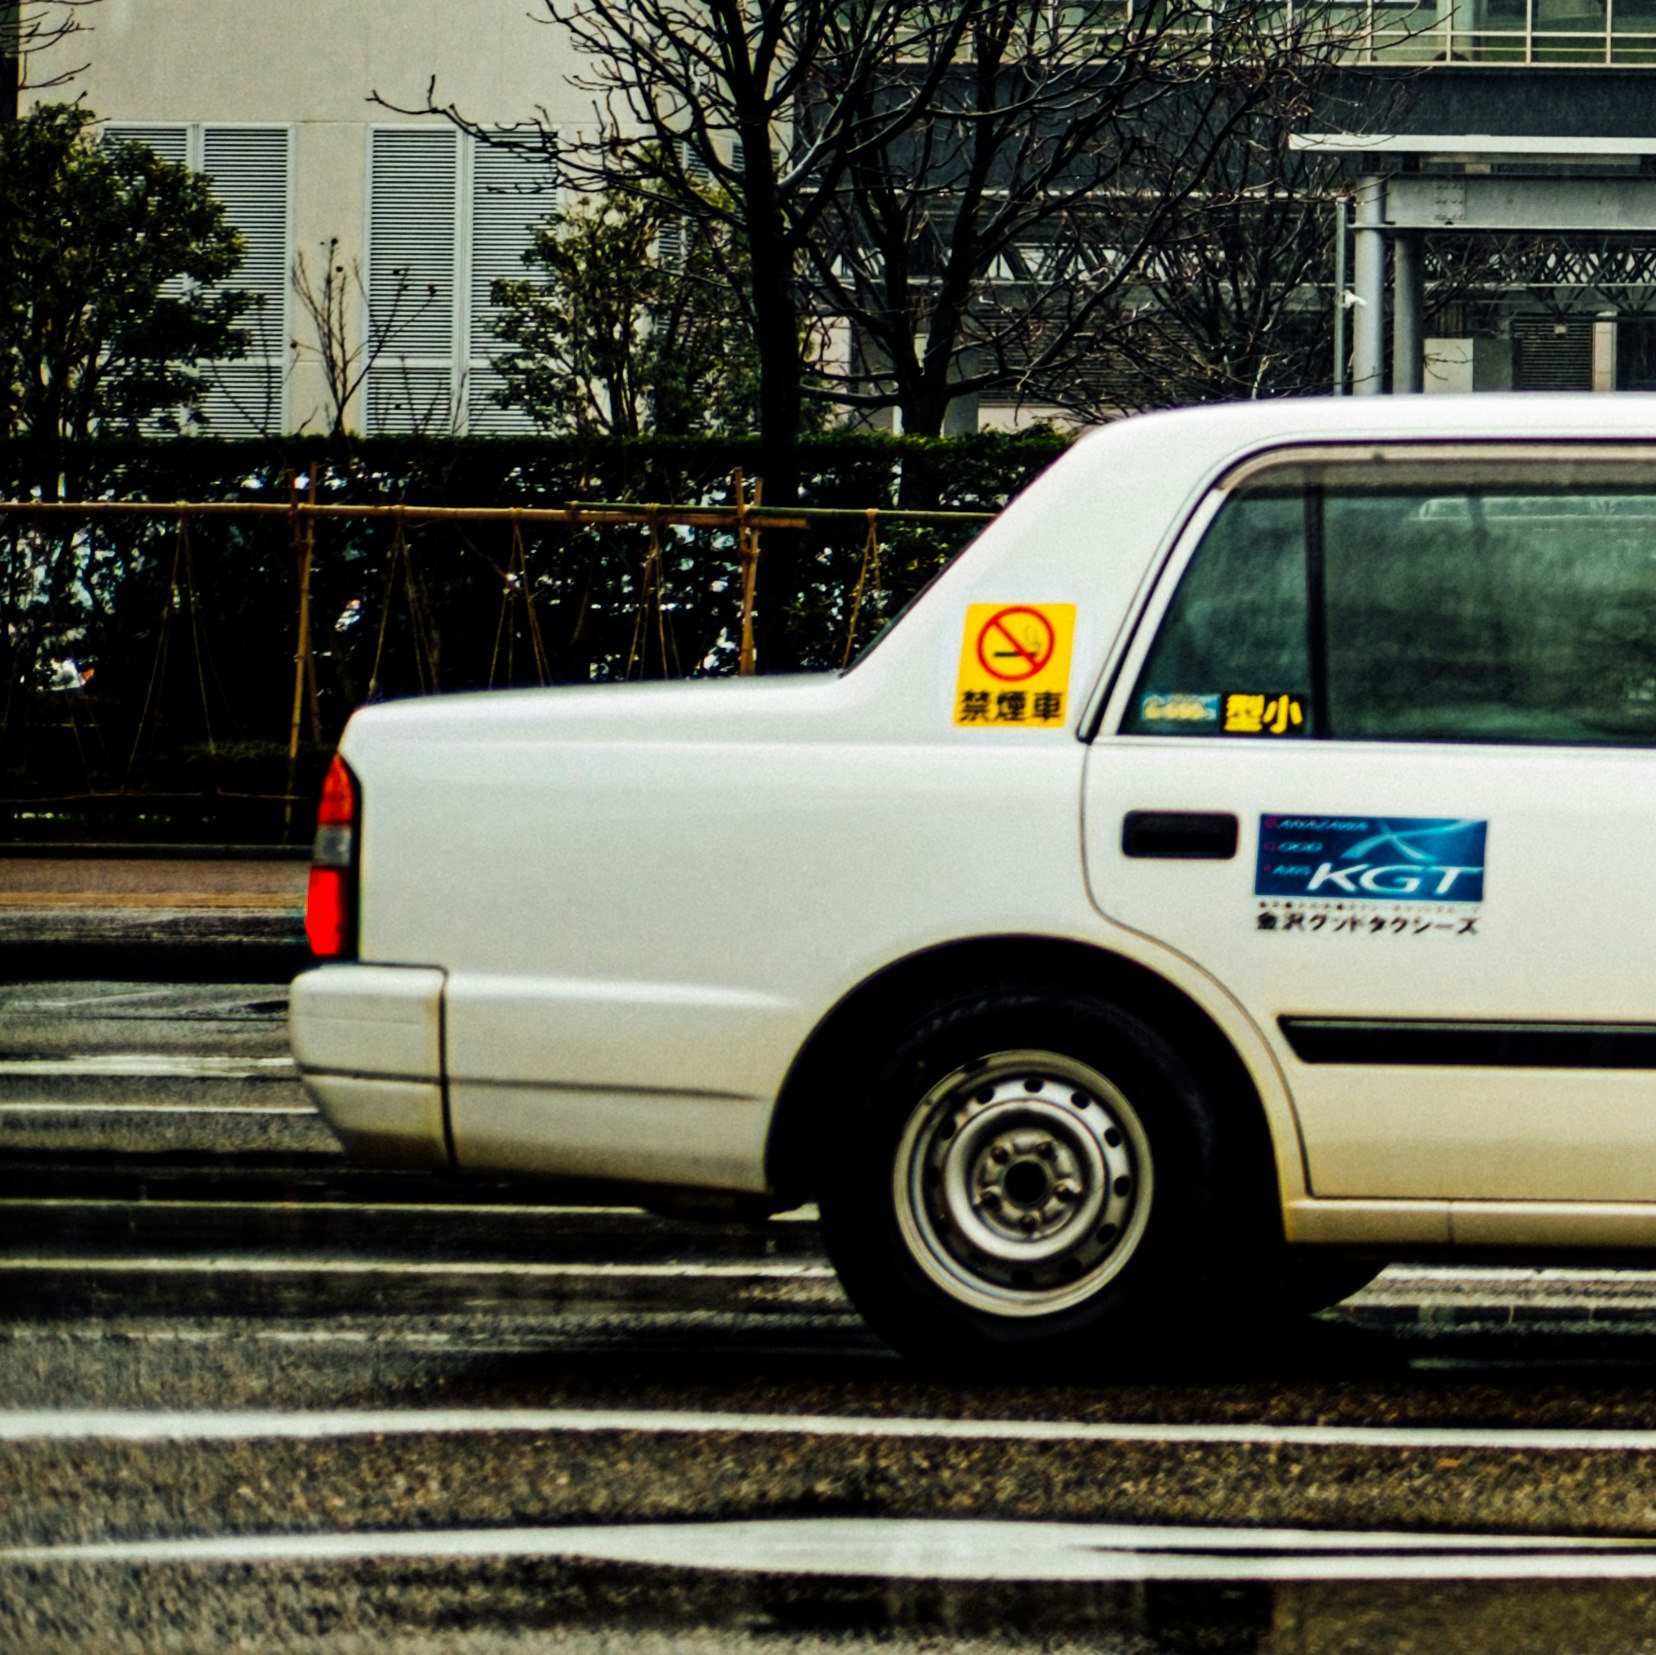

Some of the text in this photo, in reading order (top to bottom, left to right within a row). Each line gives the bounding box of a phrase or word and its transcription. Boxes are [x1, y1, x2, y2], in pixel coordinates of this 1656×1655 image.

[959, 690, 1063, 722] 禁煙車
[1305, 861, 1482, 895] KGT
